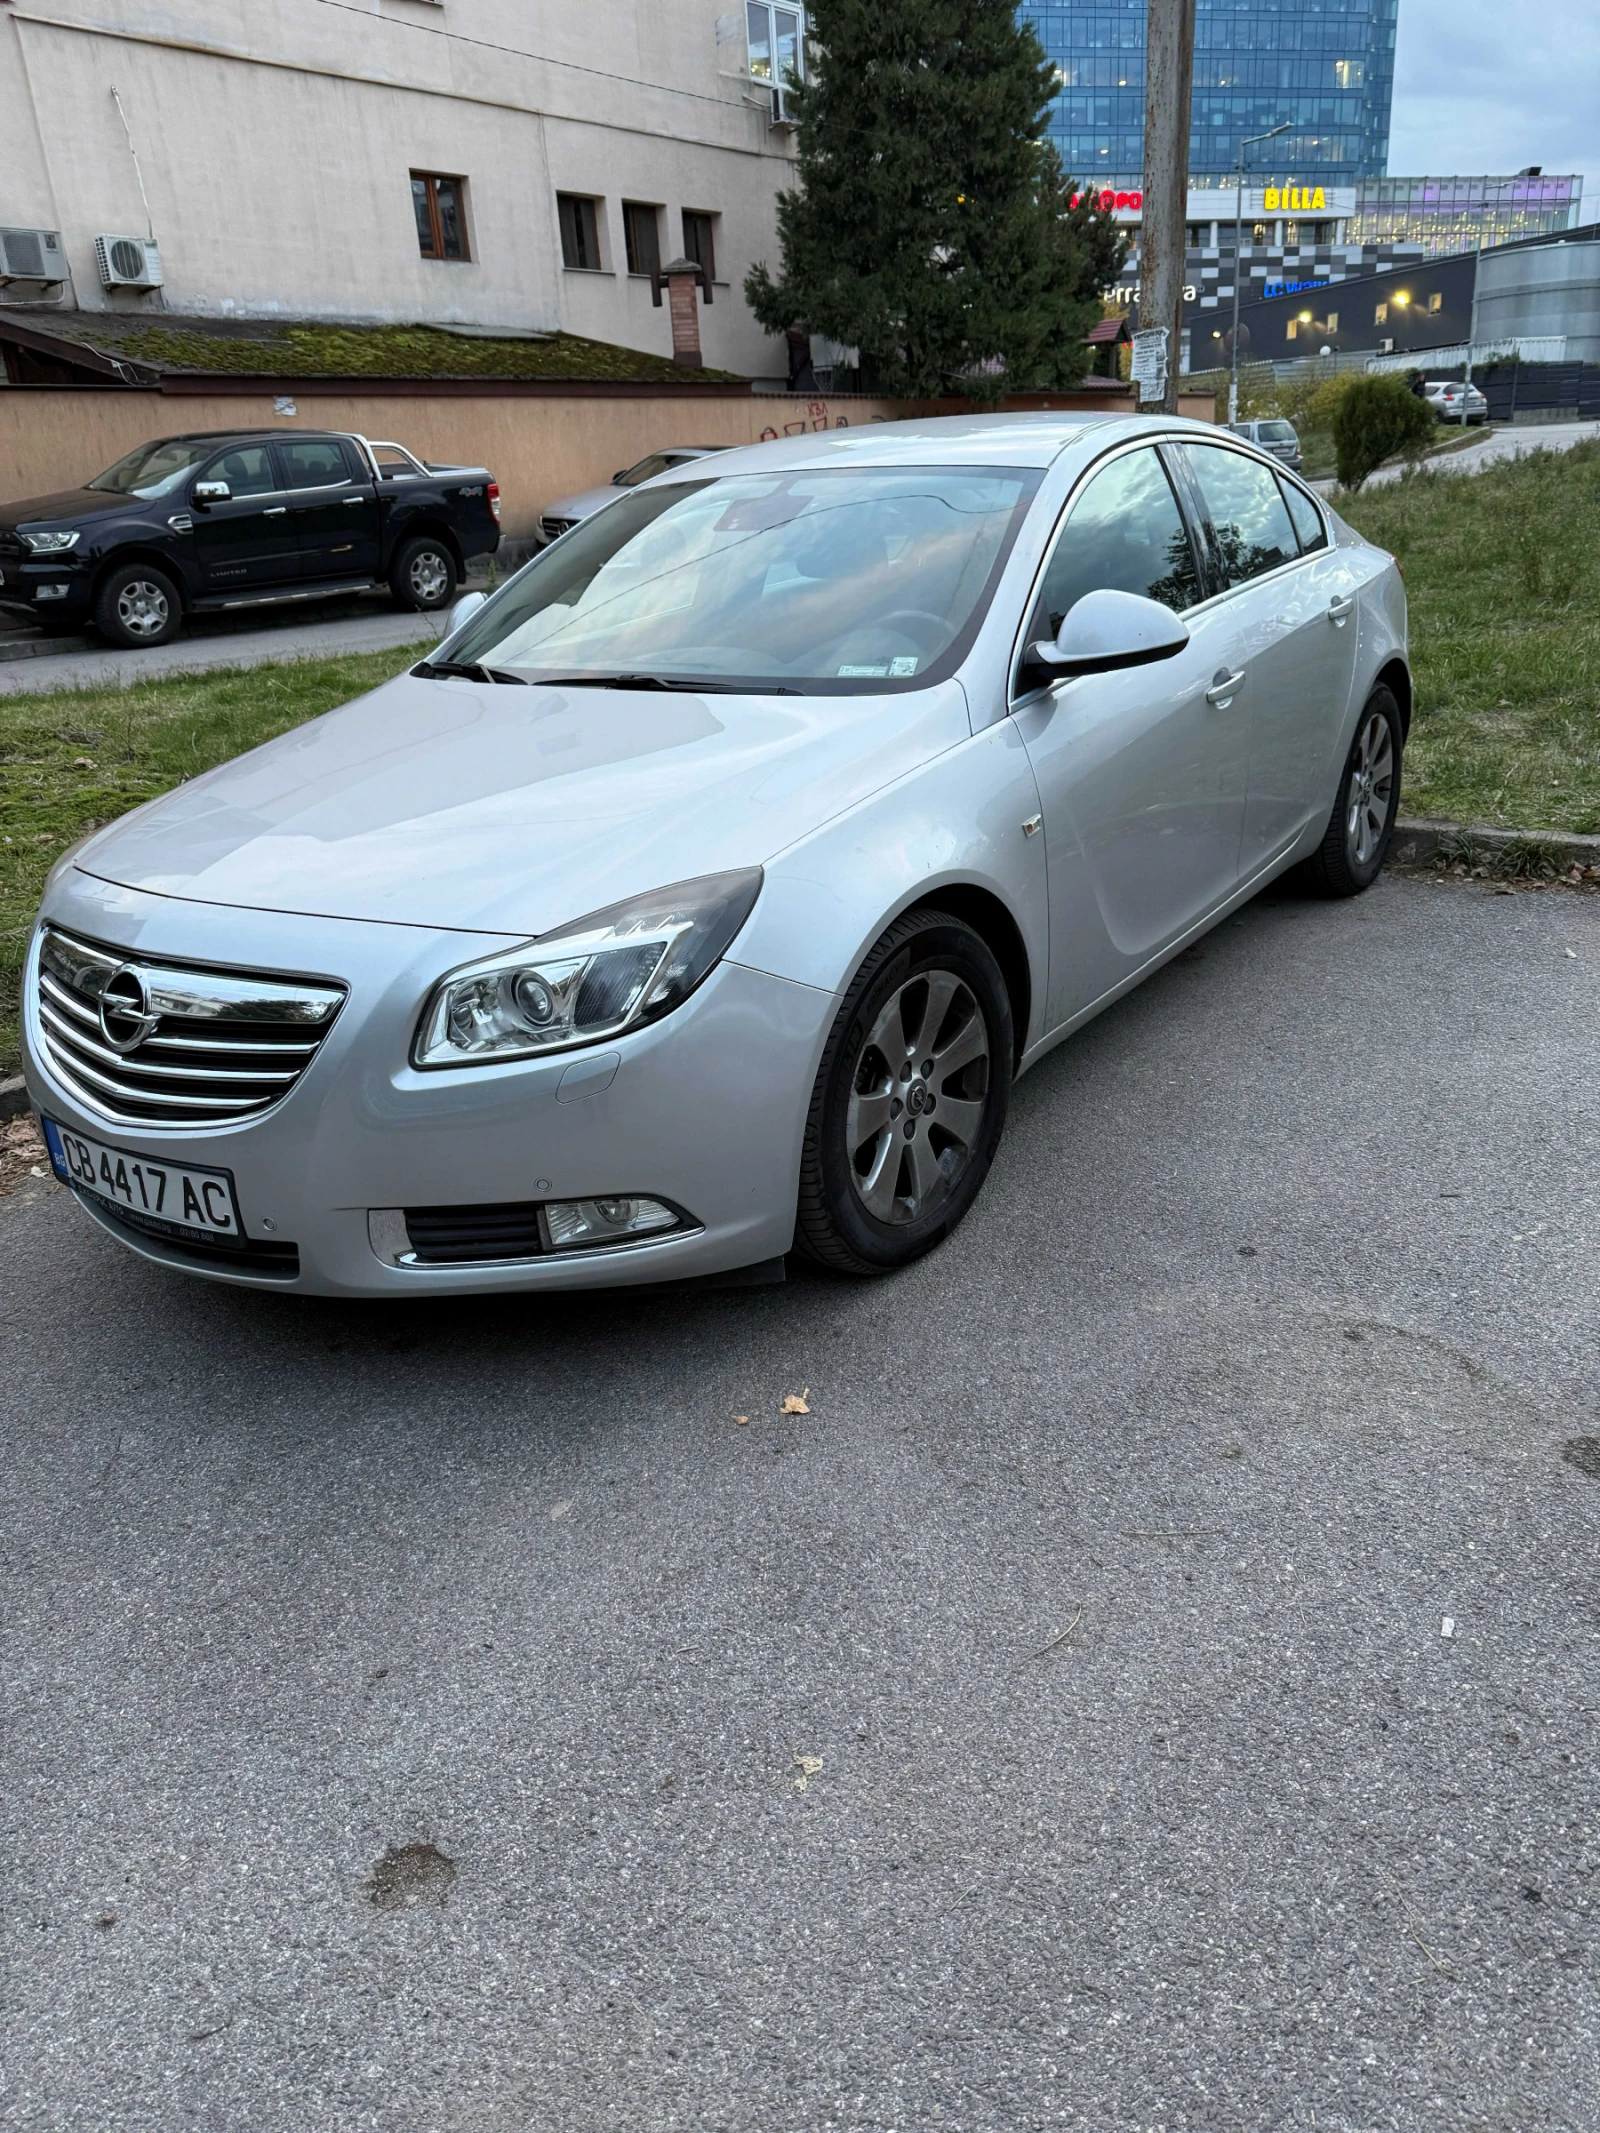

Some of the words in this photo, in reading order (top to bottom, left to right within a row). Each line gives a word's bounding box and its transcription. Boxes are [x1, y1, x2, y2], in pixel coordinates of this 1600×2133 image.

[1264, 187, 1326, 210] BILLA
[1263, 282, 1284, 298] LC
[54, 1152, 66, 1167] BG
[62, 1133, 96, 1185] CB
[100, 1151, 167, 1212] 4417
[183, 1175, 231, 1228] AC
